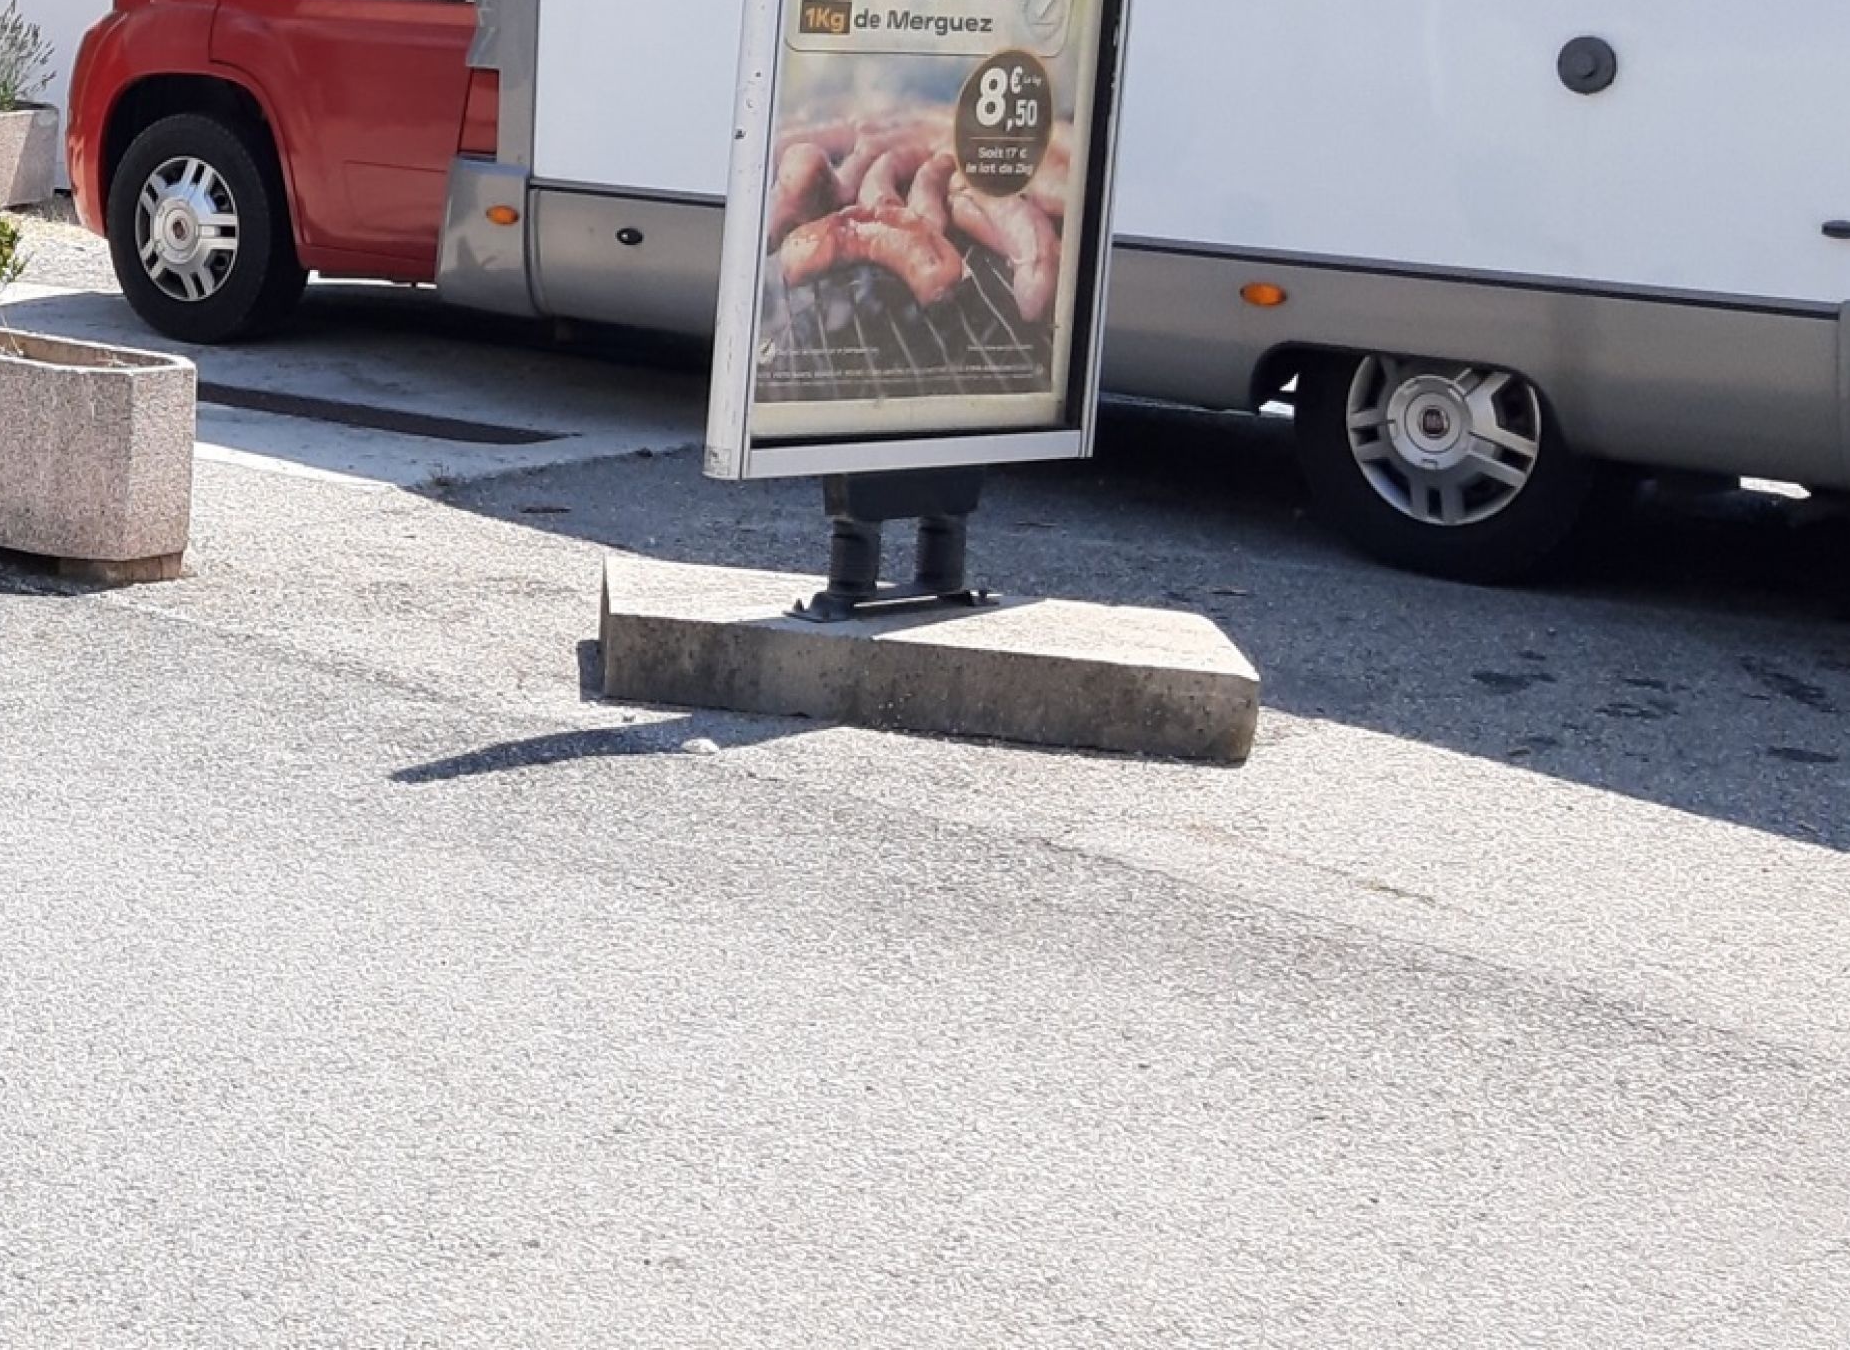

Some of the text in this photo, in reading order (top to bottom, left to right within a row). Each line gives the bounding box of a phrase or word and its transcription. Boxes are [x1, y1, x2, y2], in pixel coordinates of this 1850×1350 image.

[805, 7, 994, 36] 1Kg de Merguez
